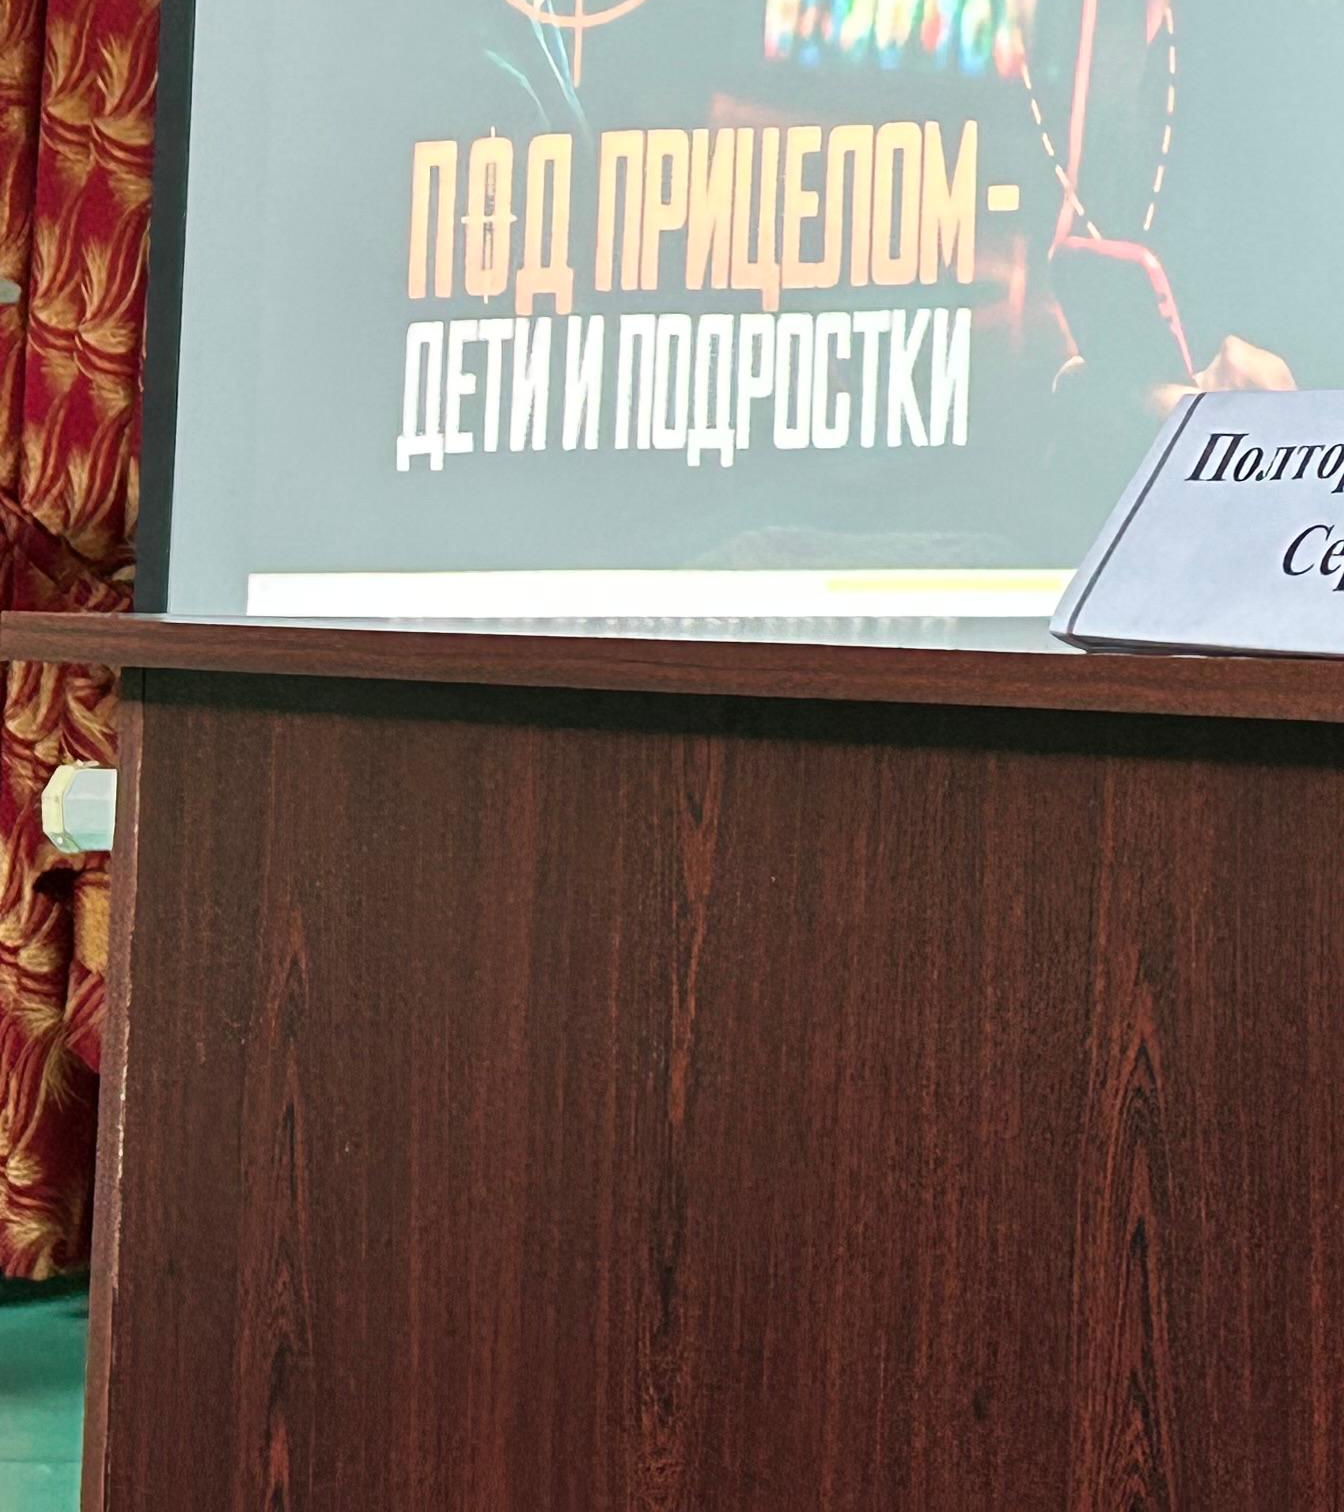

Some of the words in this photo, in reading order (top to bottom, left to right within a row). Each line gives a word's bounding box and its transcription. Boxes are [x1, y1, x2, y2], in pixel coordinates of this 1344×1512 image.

[408, 126, 574, 316] ПОД
[396, 315, 552, 472] ДЕТИ
[562, 314, 605, 452] И
[614, 307, 972, 468] ПОДРОСТКИ
